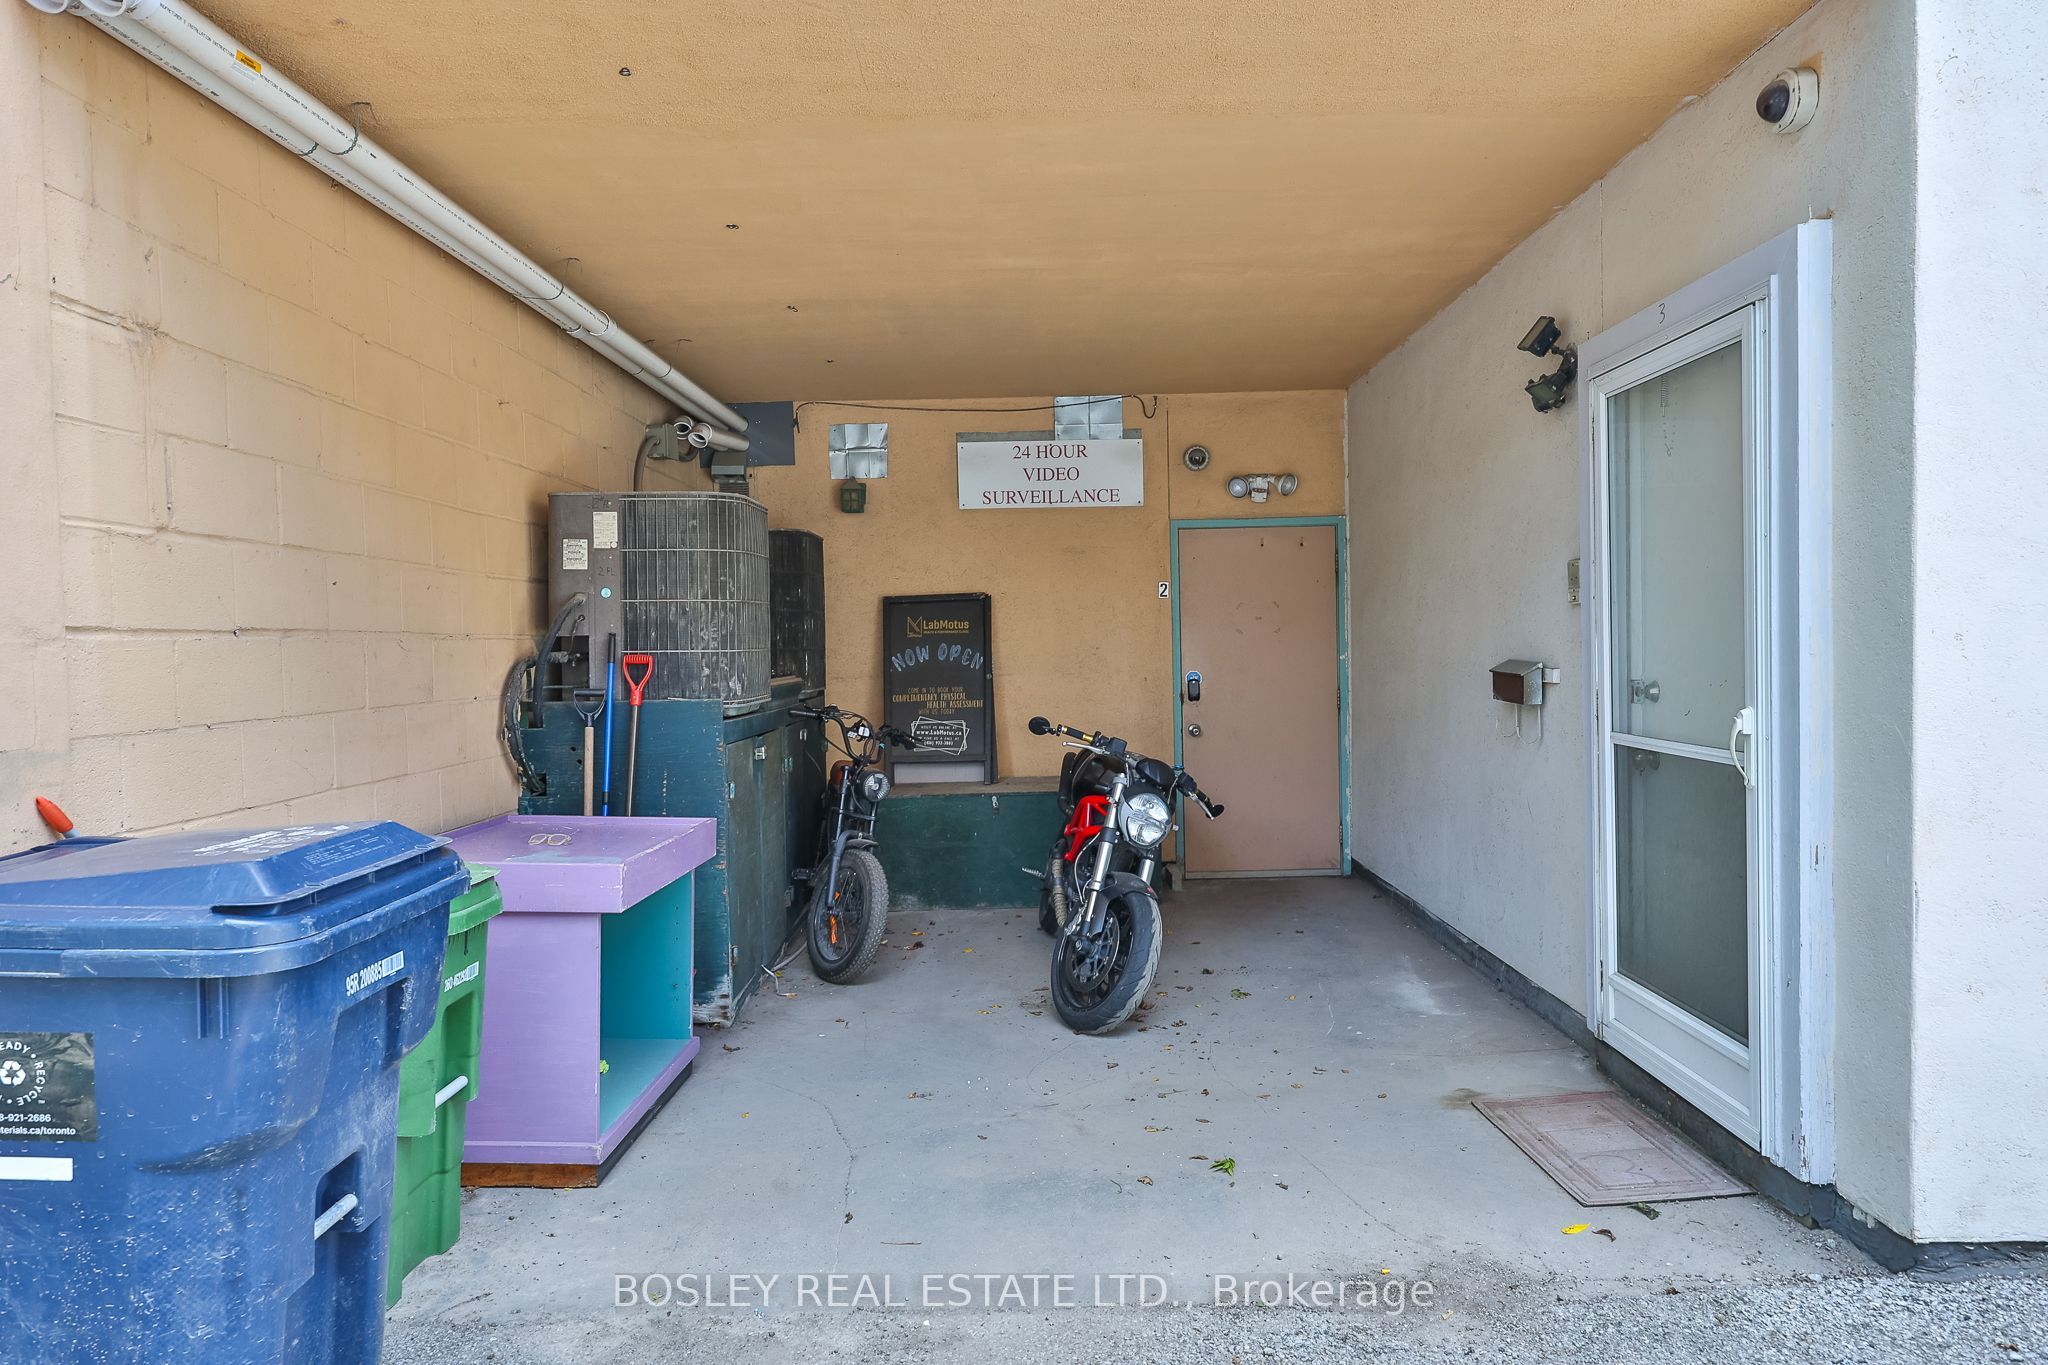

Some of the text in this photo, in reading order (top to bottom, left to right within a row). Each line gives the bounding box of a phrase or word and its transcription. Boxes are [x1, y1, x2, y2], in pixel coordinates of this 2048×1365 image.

[1658, 303, 1665, 324] 3
[1013, 444, 1088, 459] 24 HOUR
[1023, 467, 1080, 481] VIDEO
[982, 488, 1121, 505] SURVEILLANCE
[1160, 583, 1167, 597] 2
[923, 620, 969, 630] LabMotus
[892, 642, 983, 671] NOW OPEN
[940, 692, 966, 701] PHYSICAL
[926, 699, 984, 709] HEALTH ASSESSMENT
[16, 1061, 46, 1106] RECYCLE
